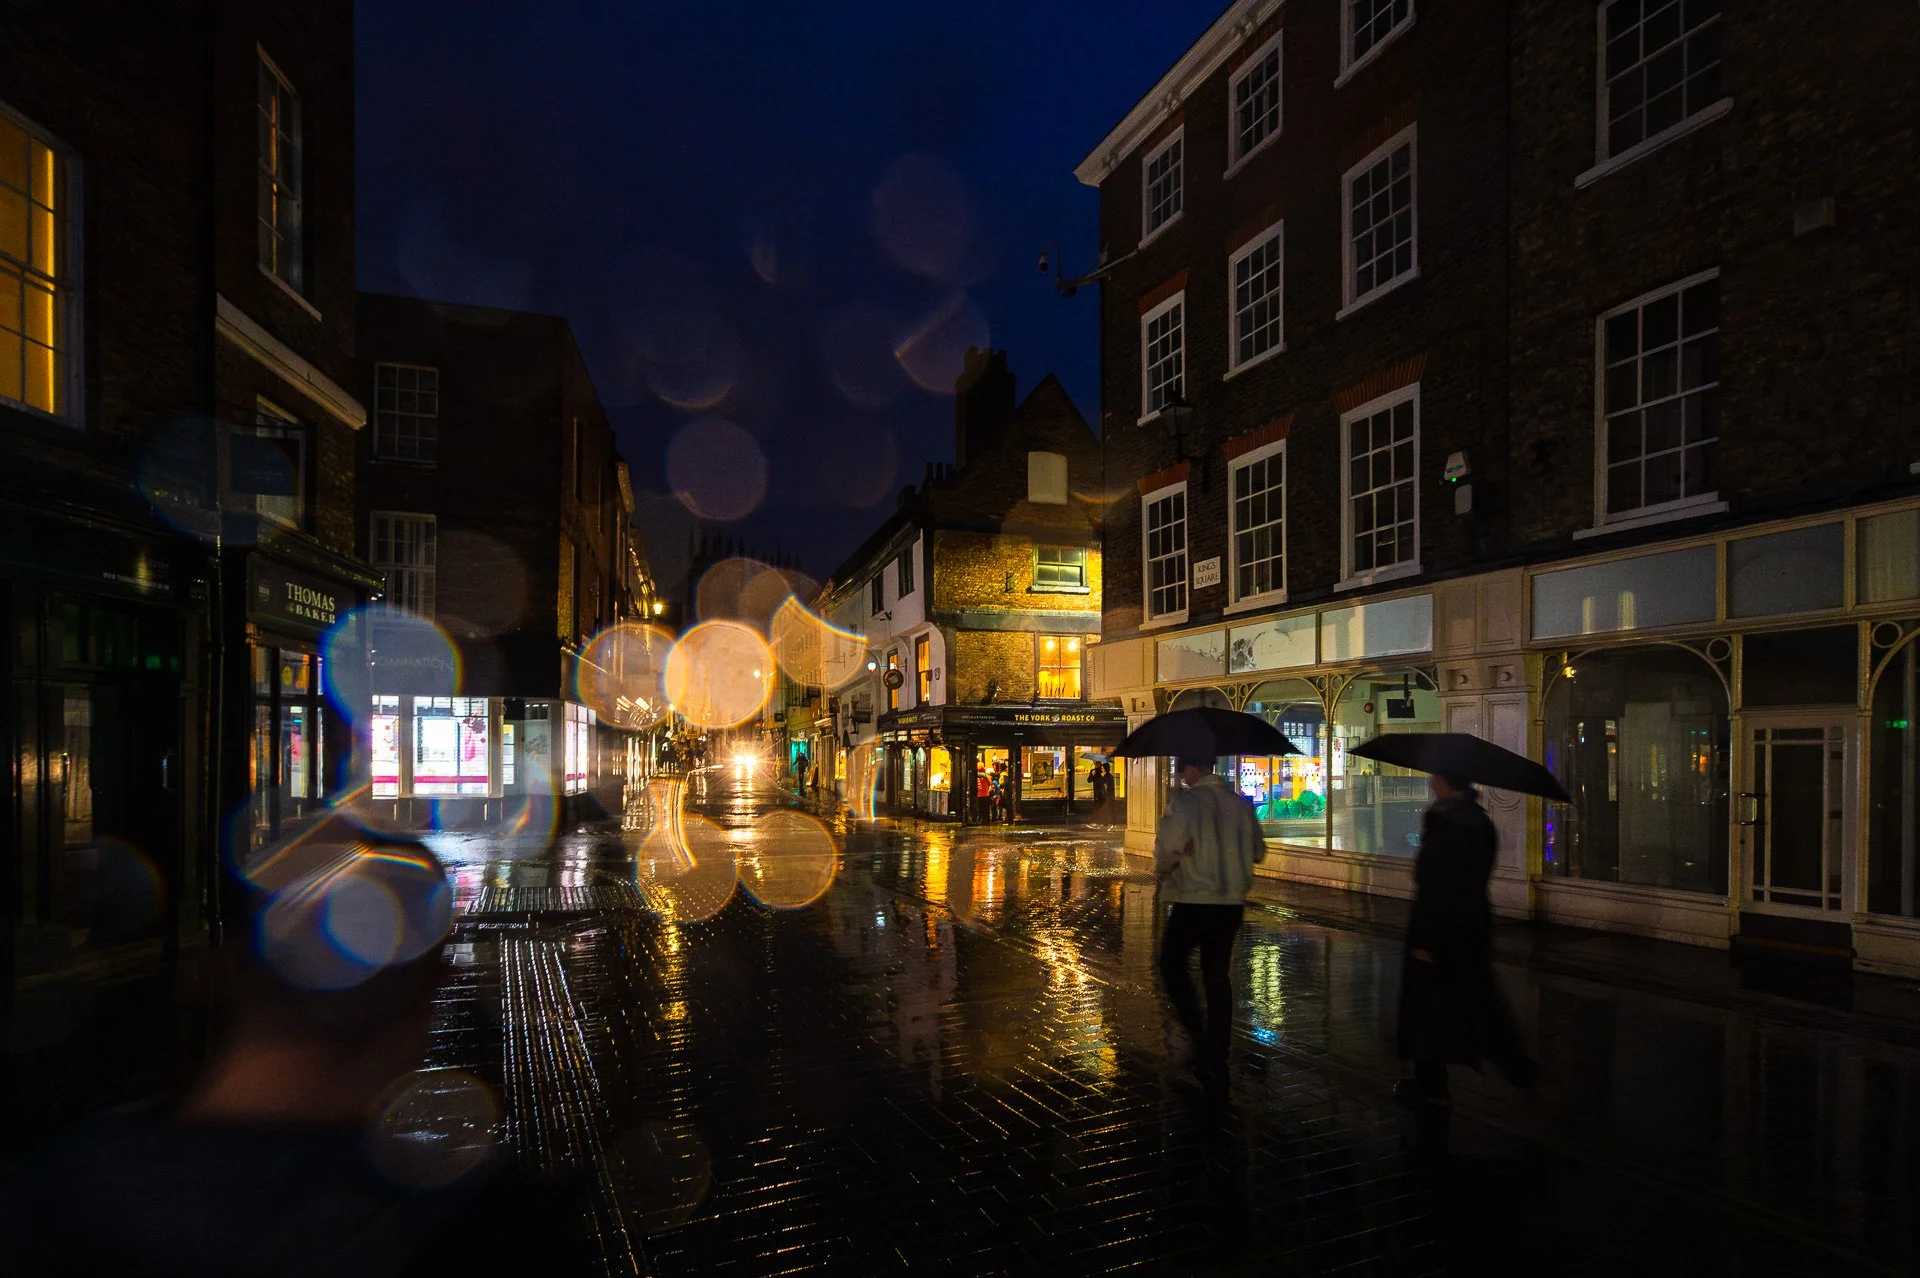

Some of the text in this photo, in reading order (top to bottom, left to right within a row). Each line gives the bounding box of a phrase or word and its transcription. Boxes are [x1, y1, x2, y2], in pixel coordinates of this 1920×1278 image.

[1195, 572, 1218, 586] SQUARE
[285, 582, 335, 612] THOMAS
[295, 604, 336, 625] BAKER
[1015, 714, 1029, 722] THE
[1030, 714, 1051, 722] YORK
[1061, 714, 1085, 722] ROAST
